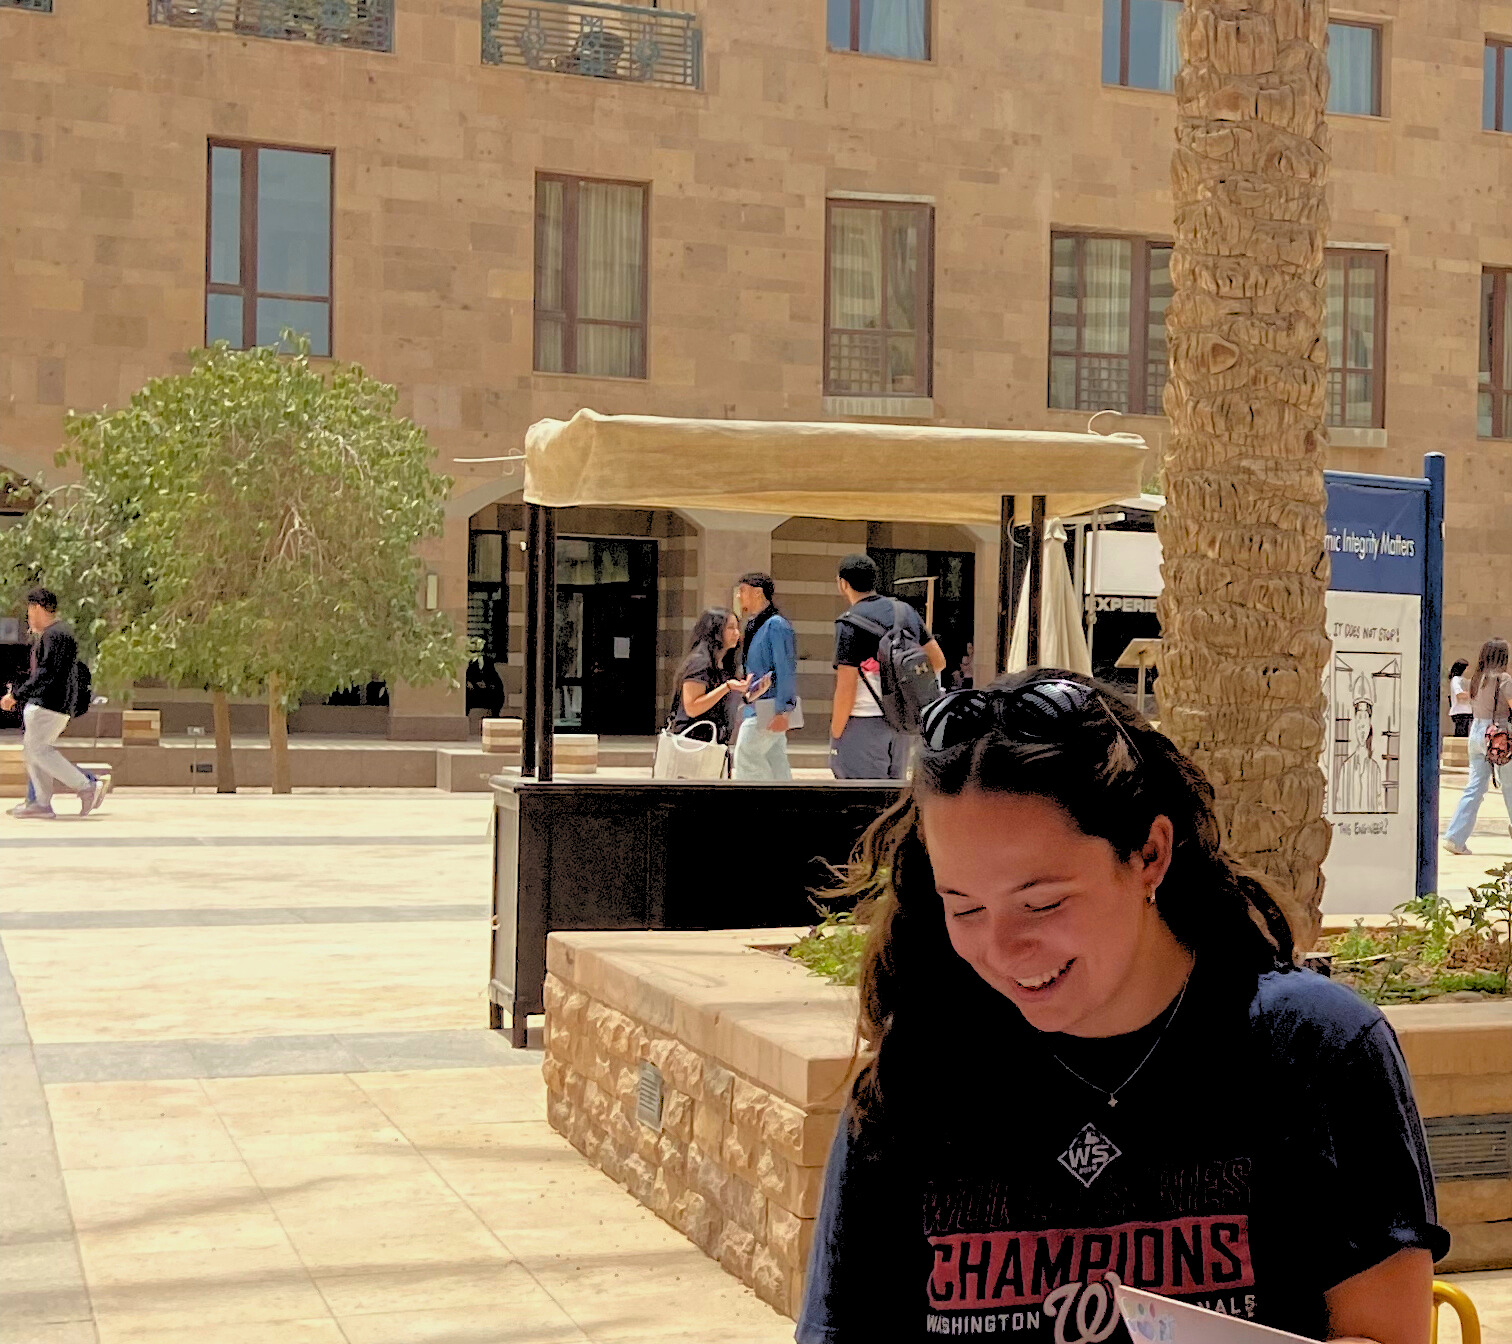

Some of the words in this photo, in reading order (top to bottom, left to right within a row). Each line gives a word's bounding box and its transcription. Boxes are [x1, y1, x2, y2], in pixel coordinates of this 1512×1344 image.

[1342, 527, 1380, 561] Integrity
[1381, 530, 1415, 557] Matters
[1068, 1144, 1109, 1169] WS
[926, 1222, 1243, 1302] CHAMPIONS
[926, 1311, 1040, 1336] WASHINGTON
